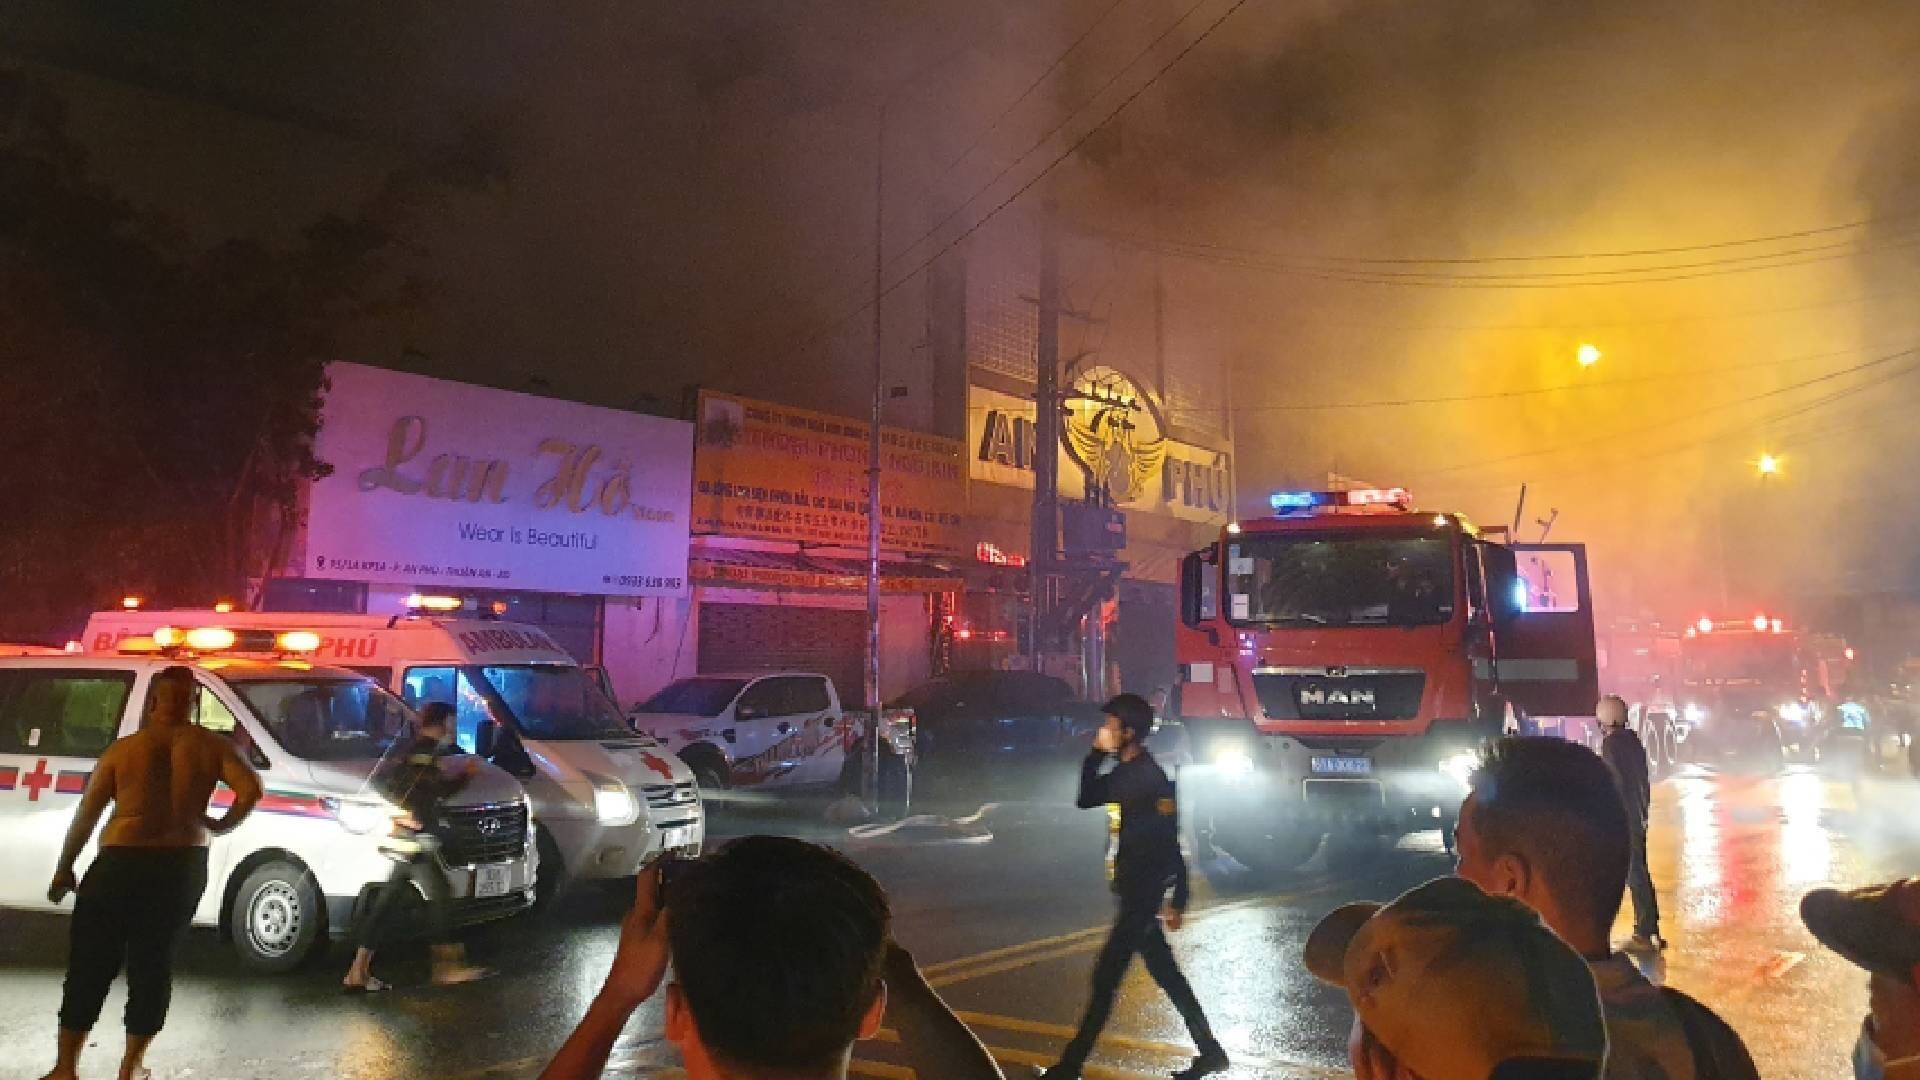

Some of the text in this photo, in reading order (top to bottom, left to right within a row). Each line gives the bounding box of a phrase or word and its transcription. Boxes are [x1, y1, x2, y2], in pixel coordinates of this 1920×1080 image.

[358, 415, 510, 504] Lan
[459, 521, 505, 543] Wear
[528, 528, 598, 550] Beautiful
[316, 633, 379, 658] PHÚ
[1300, 689, 1375, 706] MAN
